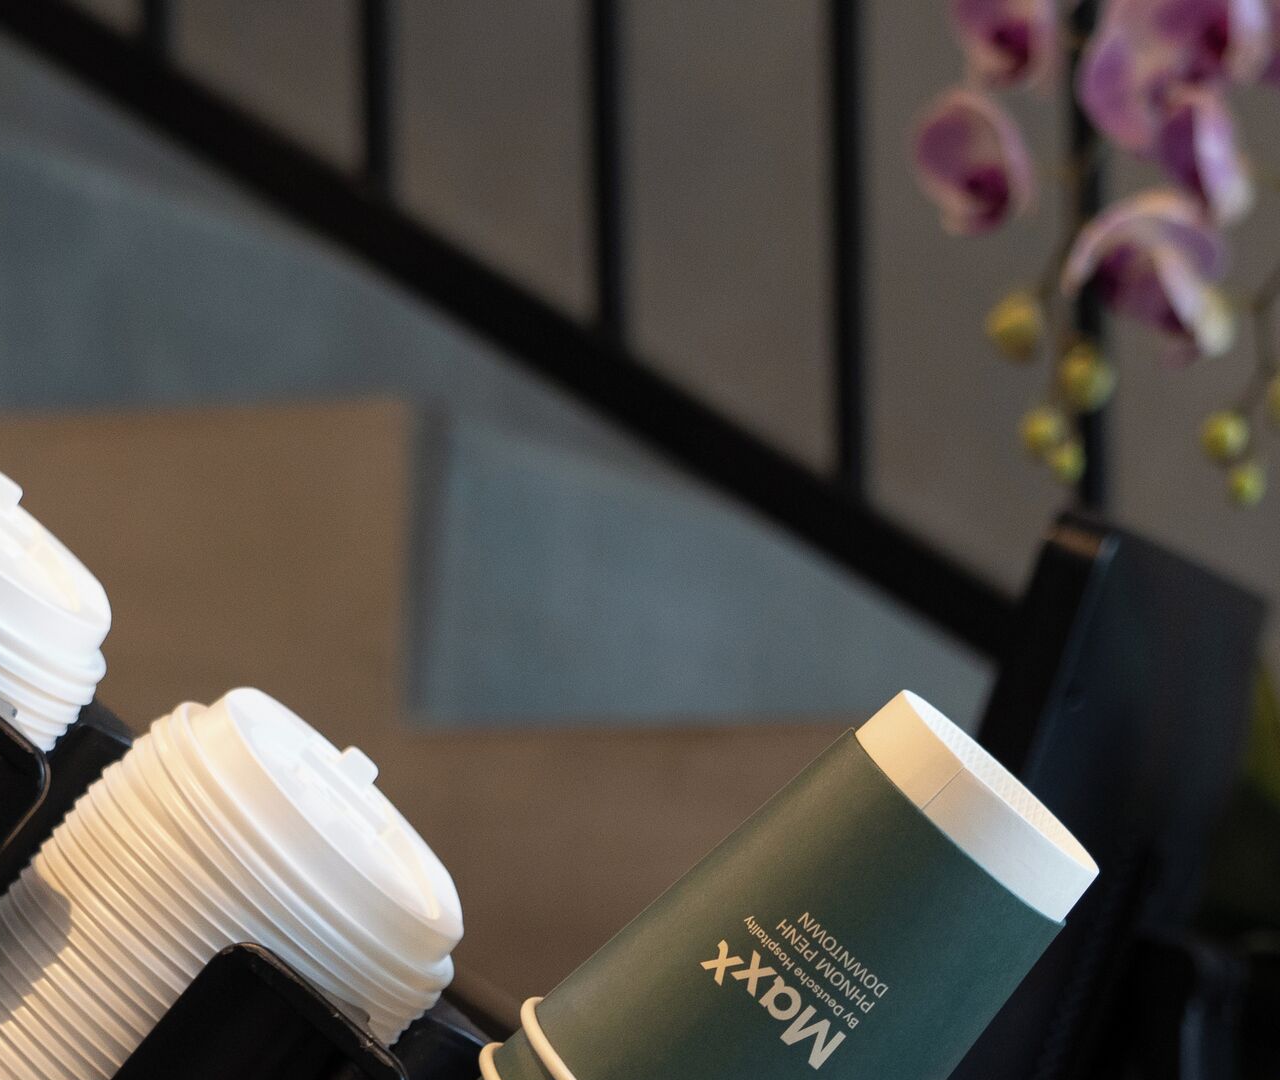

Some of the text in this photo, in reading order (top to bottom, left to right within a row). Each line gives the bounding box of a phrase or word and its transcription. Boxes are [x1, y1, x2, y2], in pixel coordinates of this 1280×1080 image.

[700, 939, 847, 1071] Maxx
[743, 915, 860, 1030] By Deutsche Hospitality
[775, 918, 875, 1014] PHNOM PENH
[797, 912, 889, 999] DOWNTOWN
